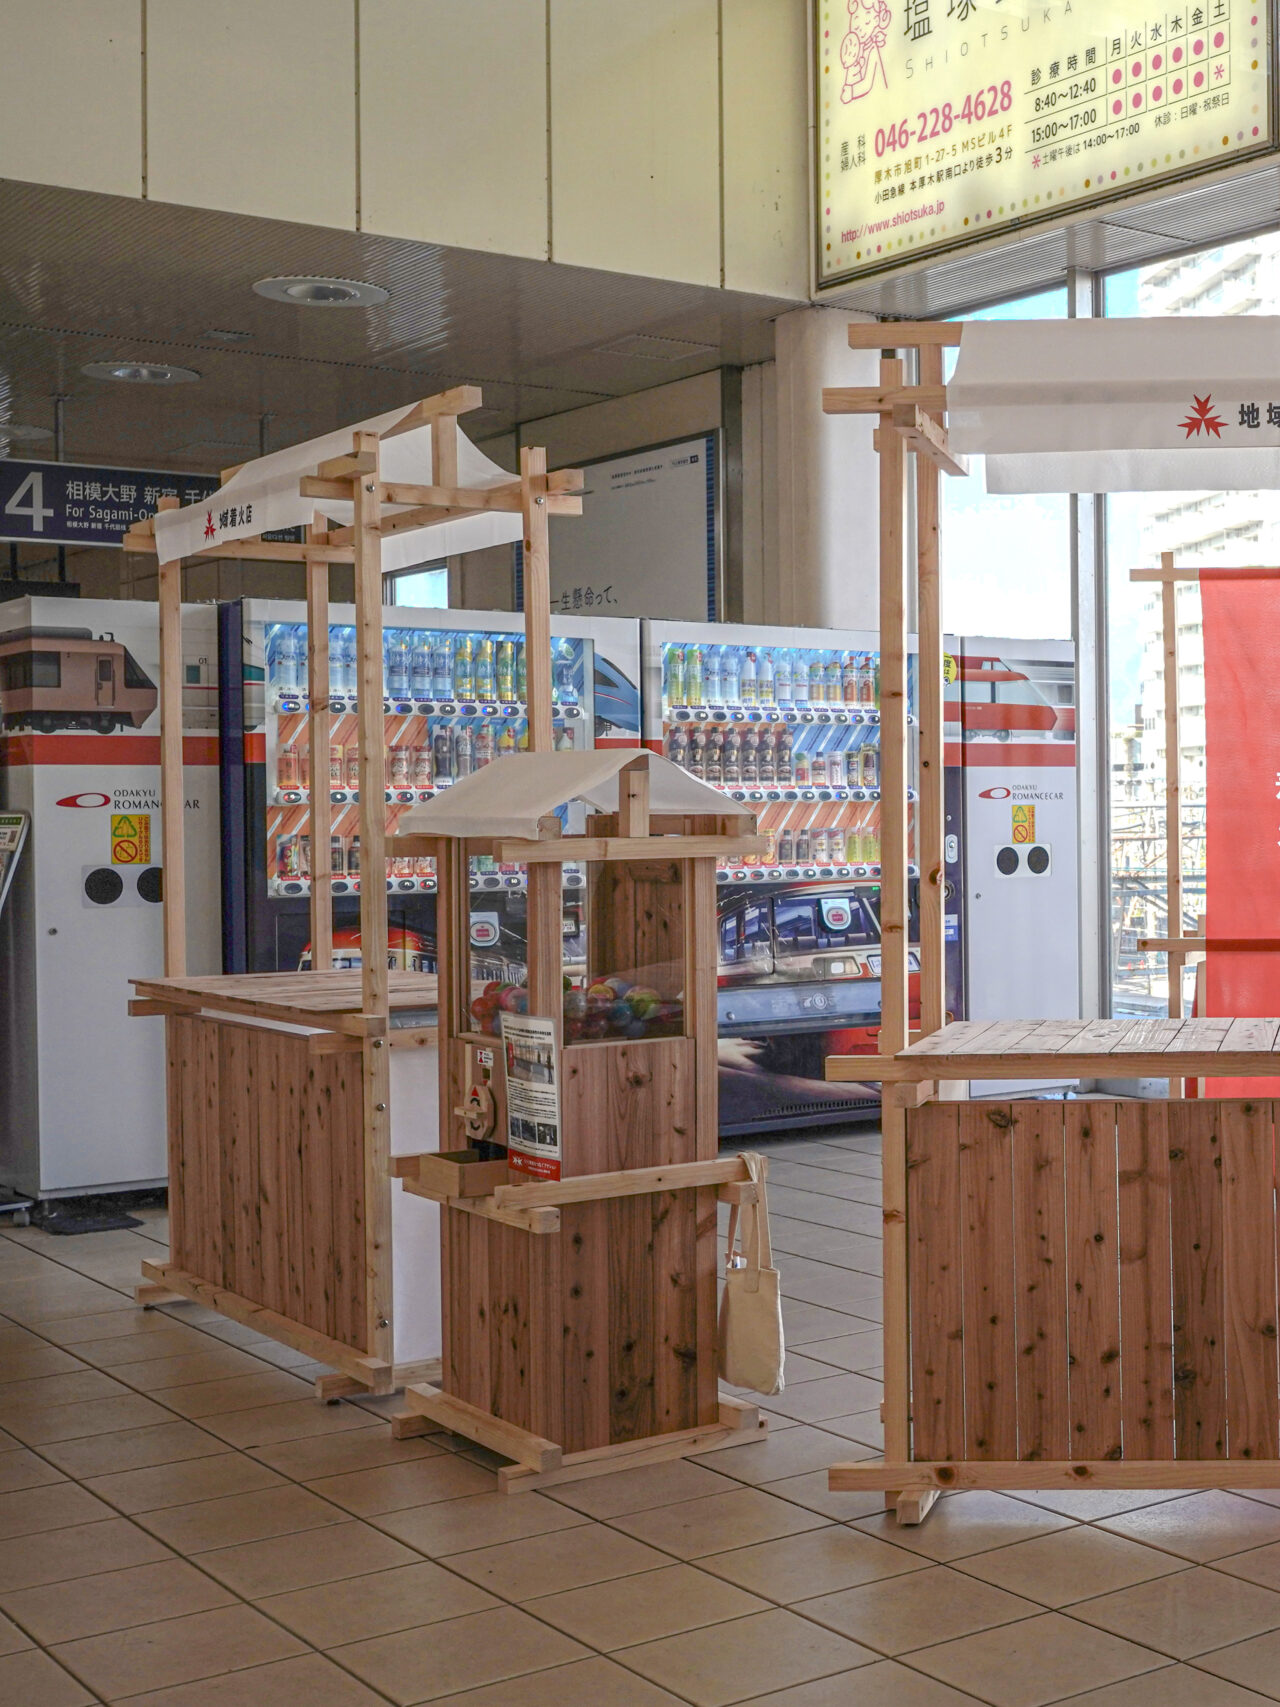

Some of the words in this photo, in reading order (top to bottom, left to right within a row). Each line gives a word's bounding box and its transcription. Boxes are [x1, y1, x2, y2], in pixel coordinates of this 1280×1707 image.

[1031, 47, 1097, 86] 診療時間
[1111, 37, 1122, 55] 月
[1130, 30, 1142, 49] 火
[1150, 23, 1162, 41] 水
[1171, 16, 1183, 33] 木
[1191, 8, 1203, 26] 金
[1213, 0, 1225, 18] 土
[874, 80, 1012, 157] 046-228-4628
[841, 200, 945, 243] http://www.shiotsuka.jp
[5, 472, 54, 531] 4
[66, 480, 137, 503] 相模大野
[66, 504, 85, 517] For
[114, 789, 156, 797] ODAKYU
[1012, 792, 1064, 800] ROMANCECAR
[114, 800, 200, 810] ROMANAR
